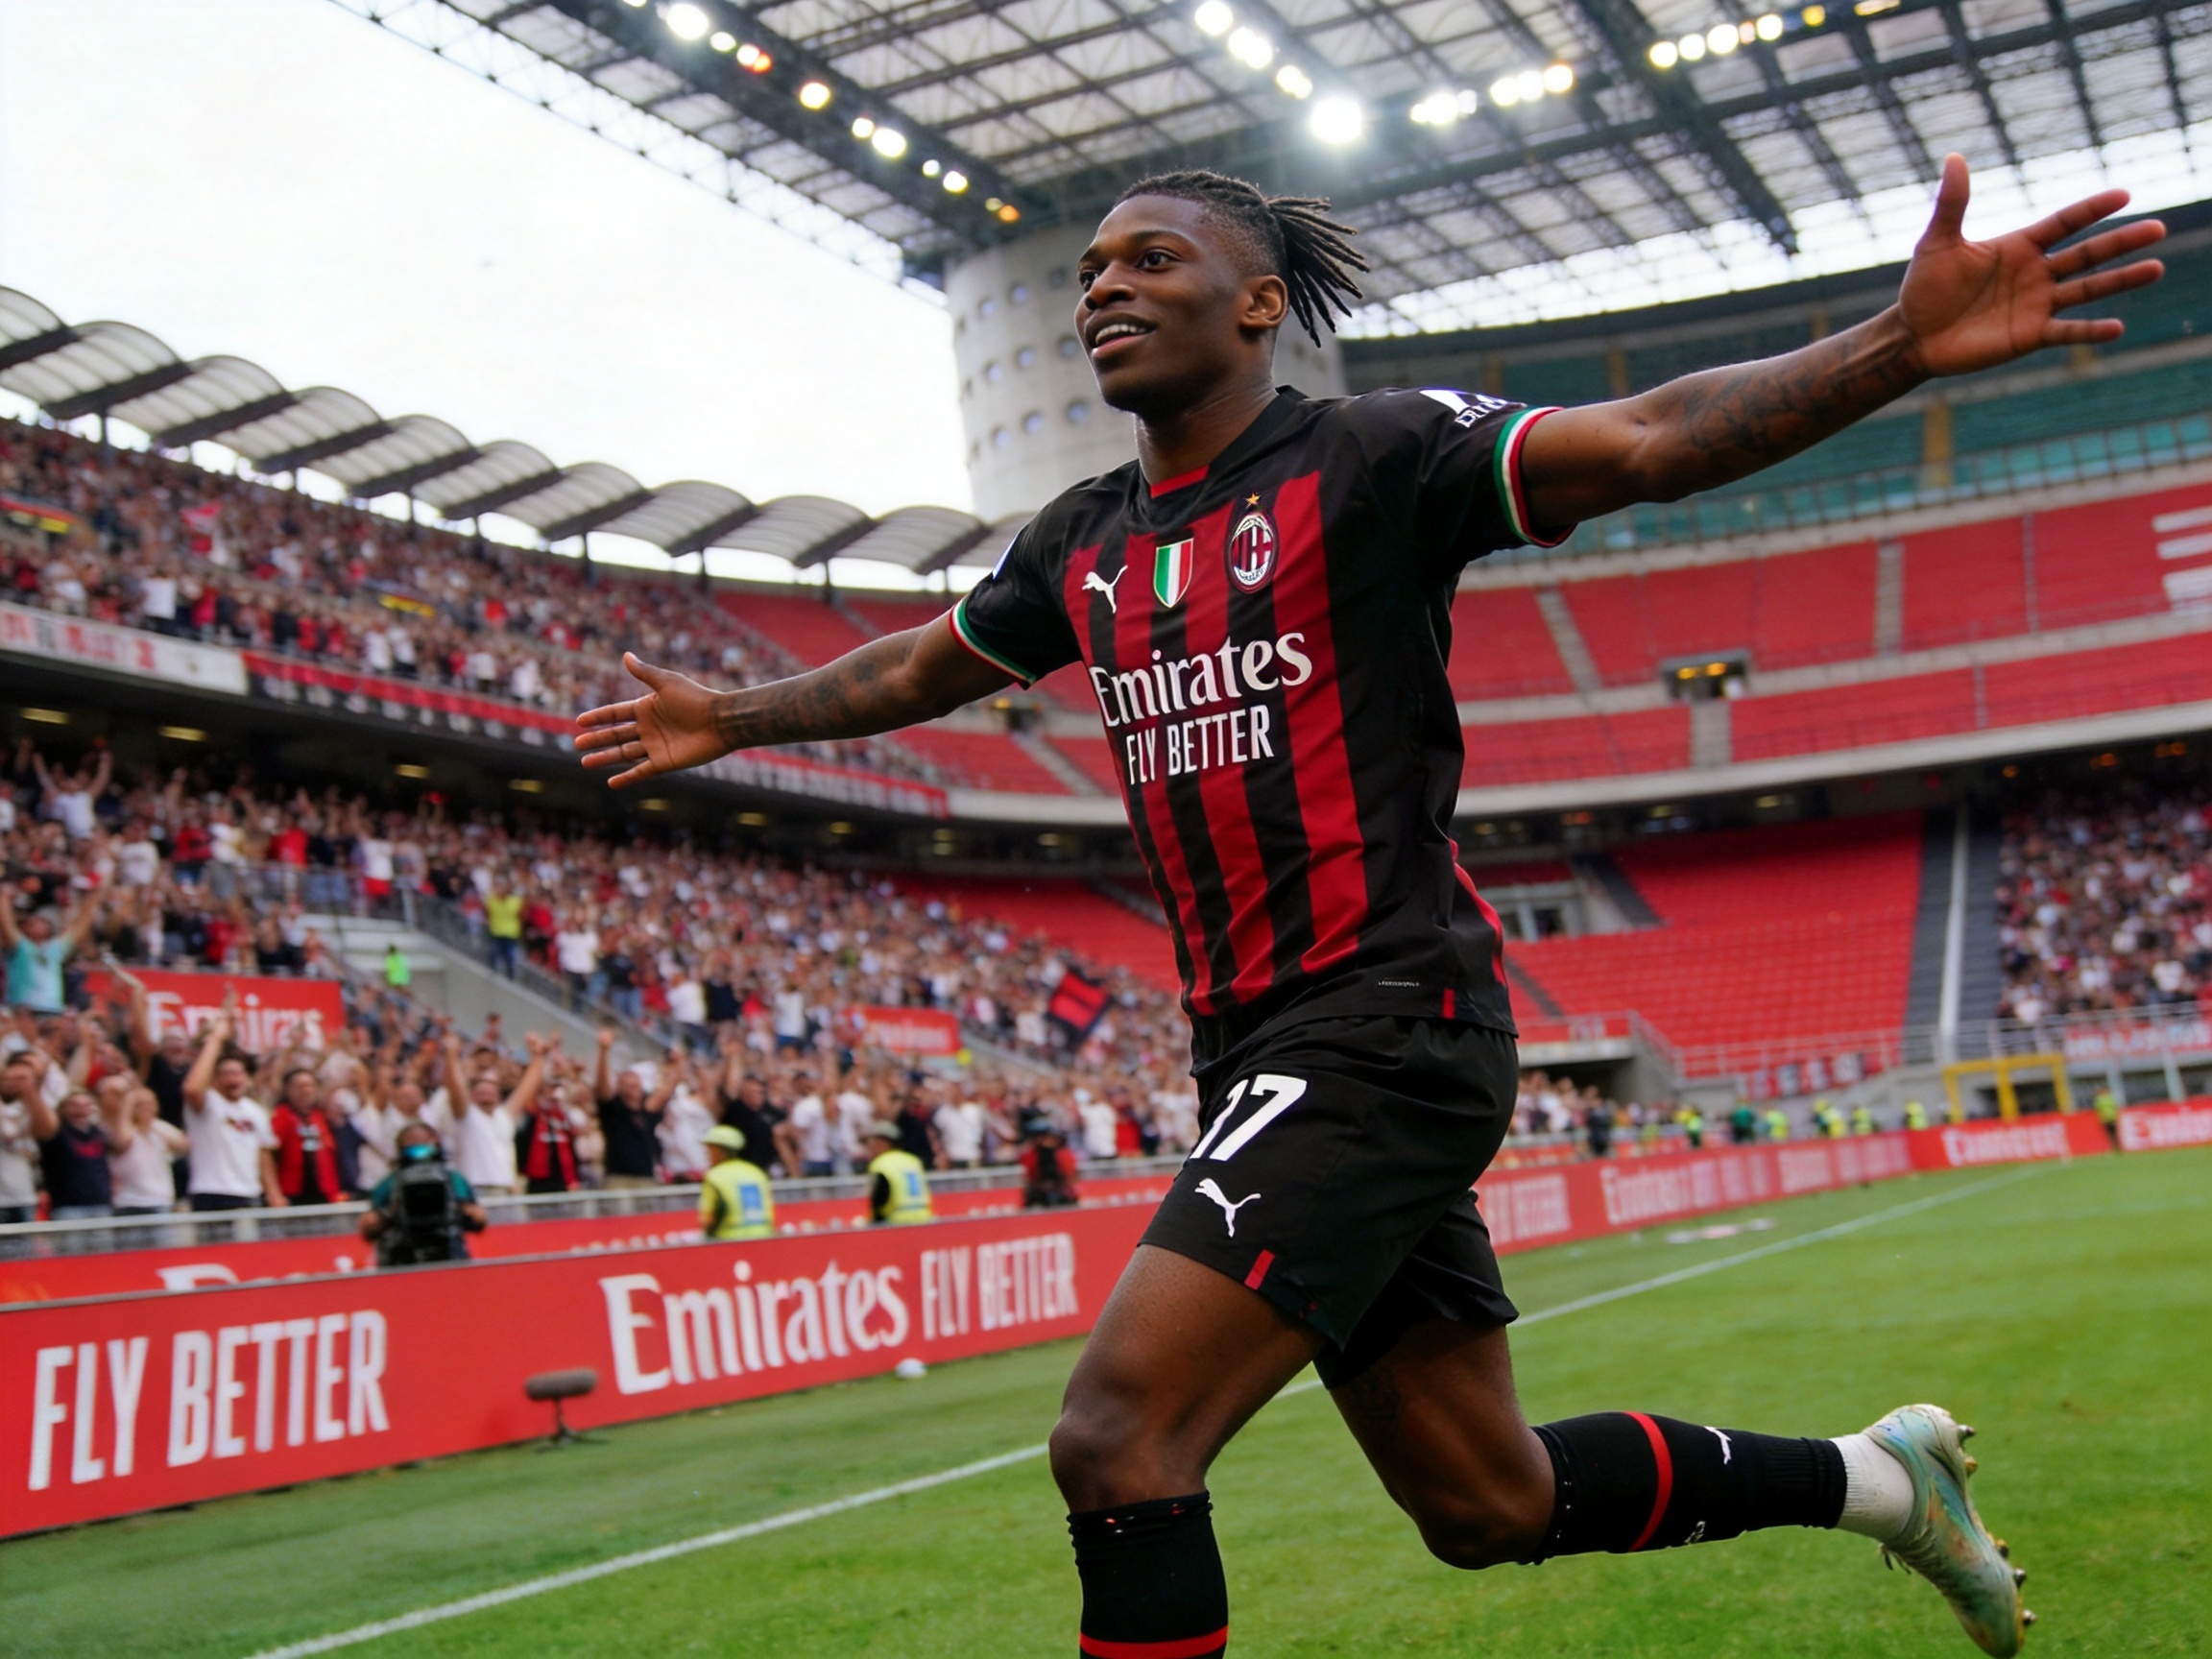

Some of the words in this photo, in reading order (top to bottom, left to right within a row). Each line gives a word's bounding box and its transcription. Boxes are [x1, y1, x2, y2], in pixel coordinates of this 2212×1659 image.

[1089, 633, 1312, 727] Emirates
[1126, 728, 1156, 785] FLY
[1166, 705, 1275, 776] BETTER
[1190, 1073, 1308, 1162] 17
[599, 1260, 908, 1395] Emirates
[921, 1246, 971, 1340] FLY
[978, 1233, 1079, 1331] BETTER
[28, 1336, 149, 1491] FLY
[166, 1309, 390, 1468] BETTER
